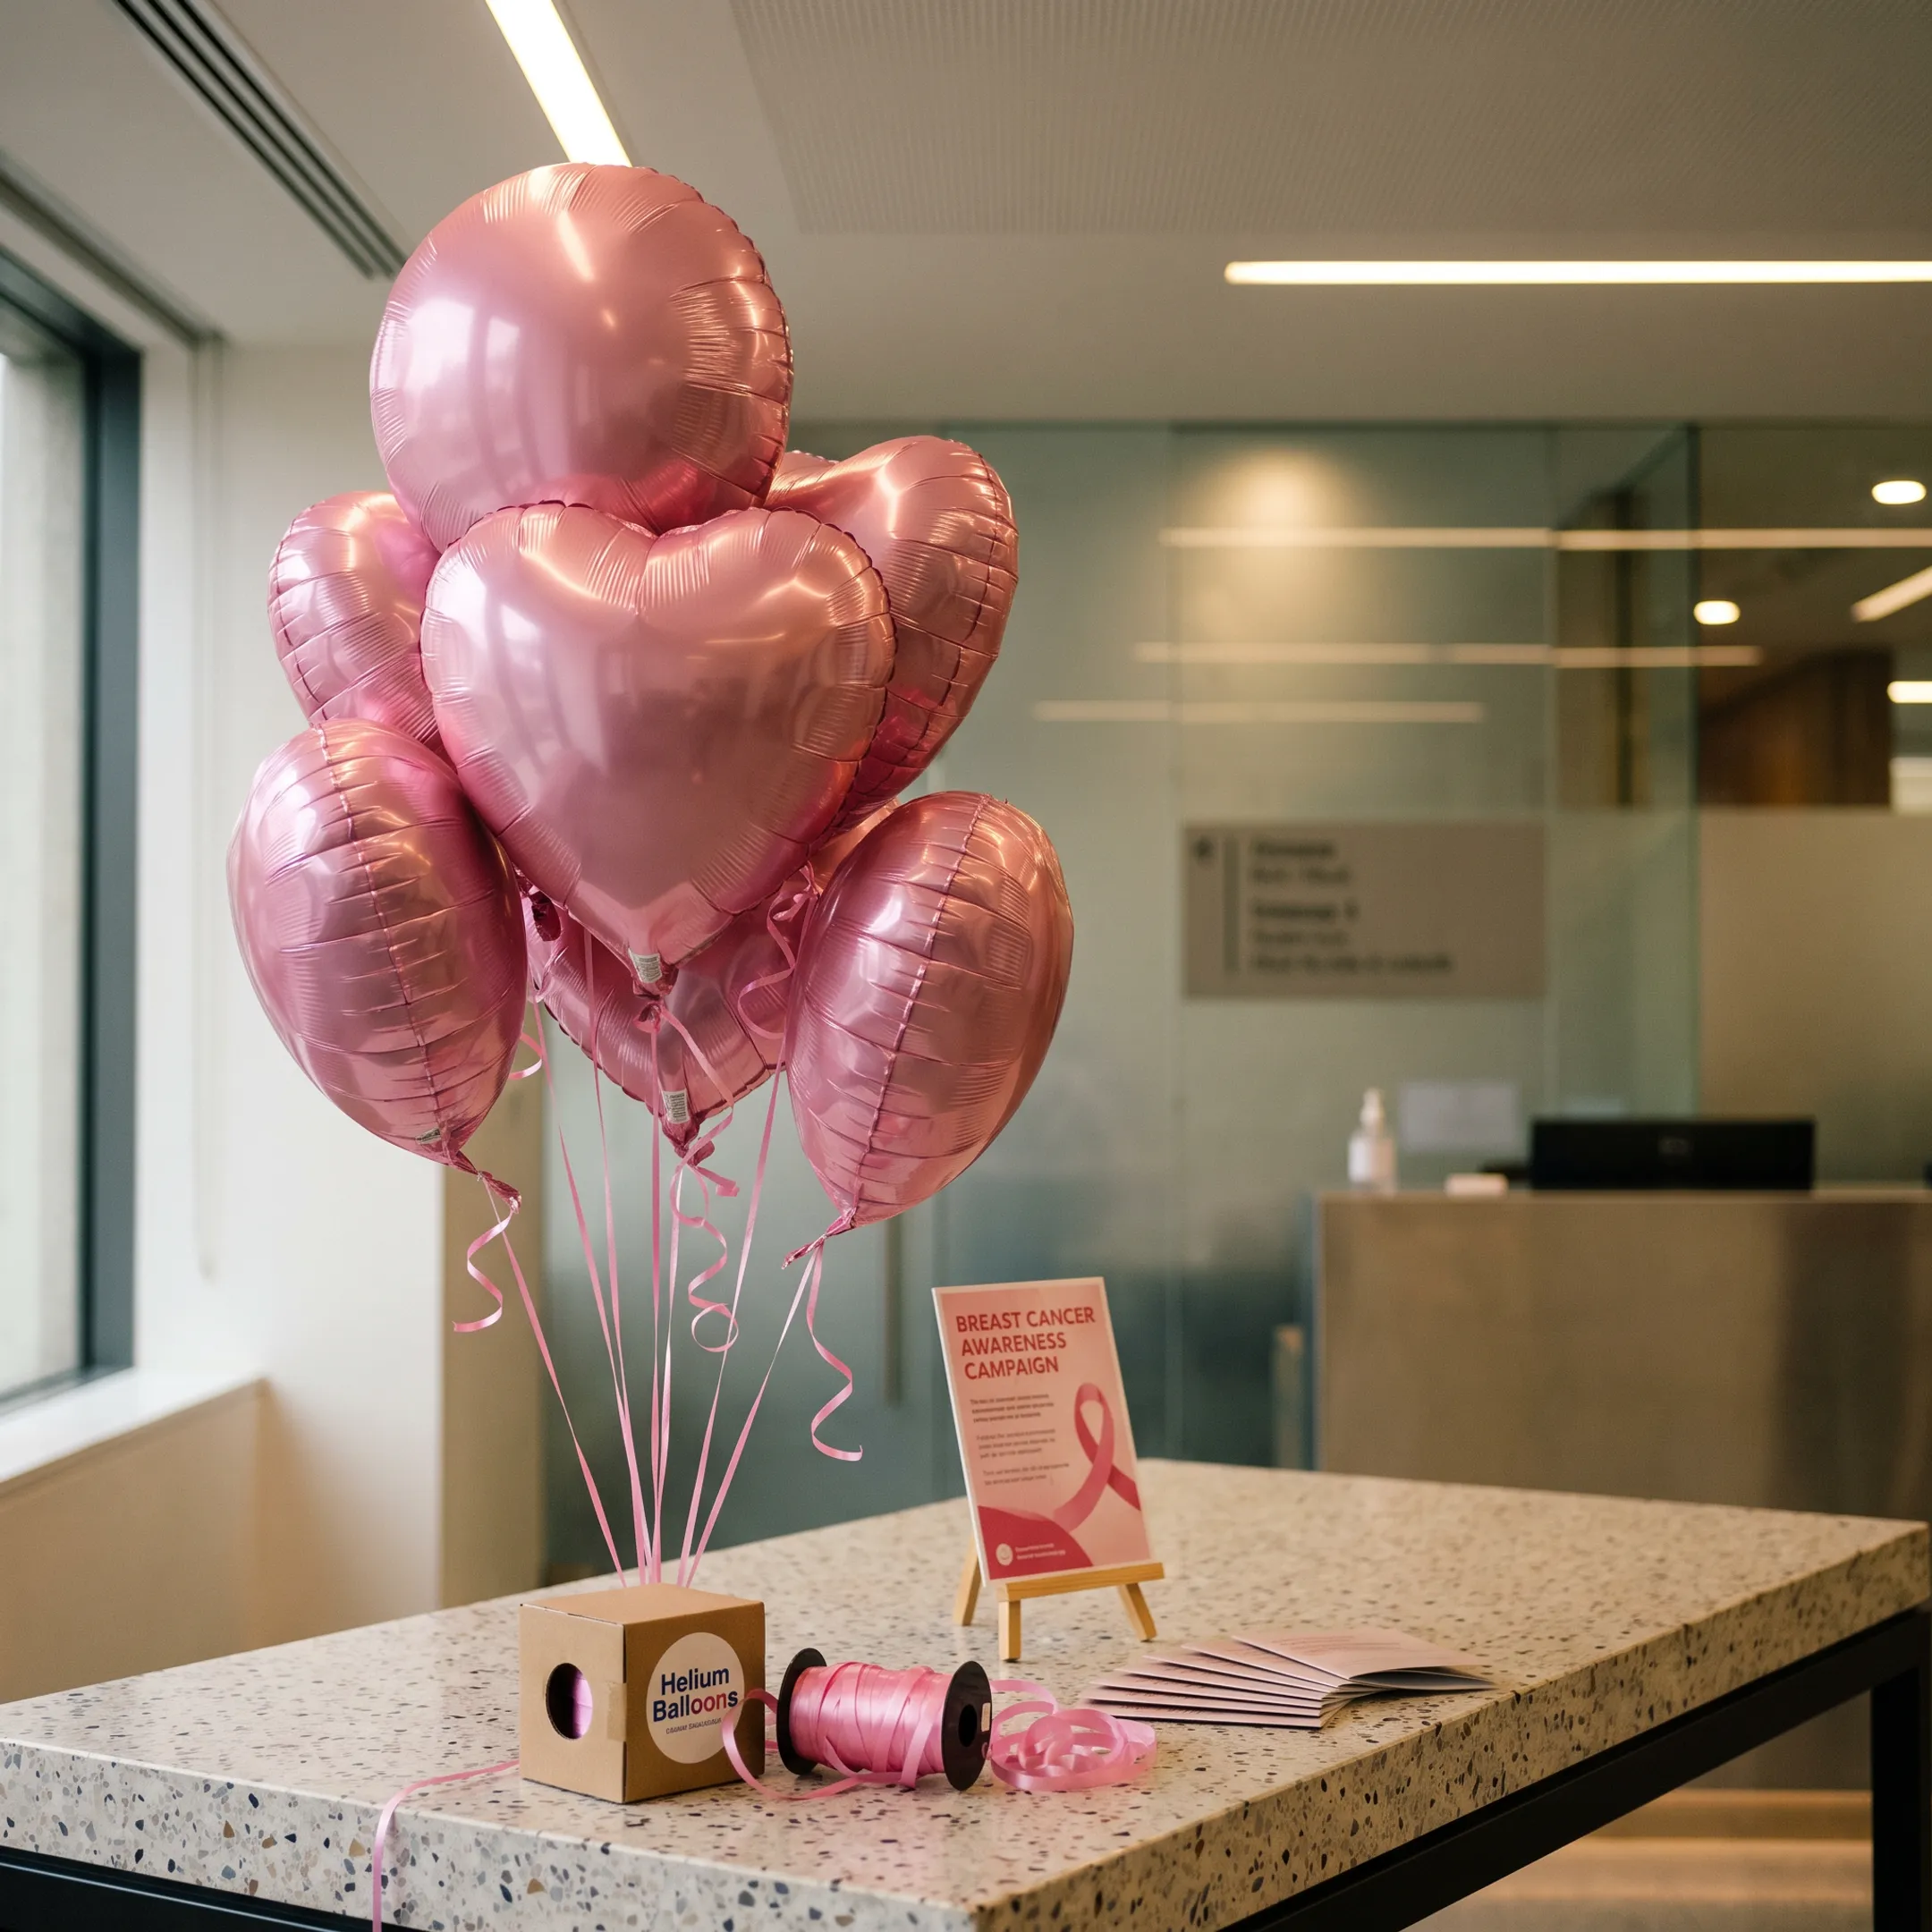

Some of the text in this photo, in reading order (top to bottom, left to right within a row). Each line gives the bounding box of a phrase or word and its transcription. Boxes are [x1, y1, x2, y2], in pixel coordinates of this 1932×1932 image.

[956, 1307, 1096, 1333] BREAST CANCER
[962, 1332, 1067, 1356] AWARENESS
[964, 1356, 1059, 1380] CAMPAIGN
[661, 1668, 729, 1696] Helium
[653, 1690, 738, 1723] Balloons
